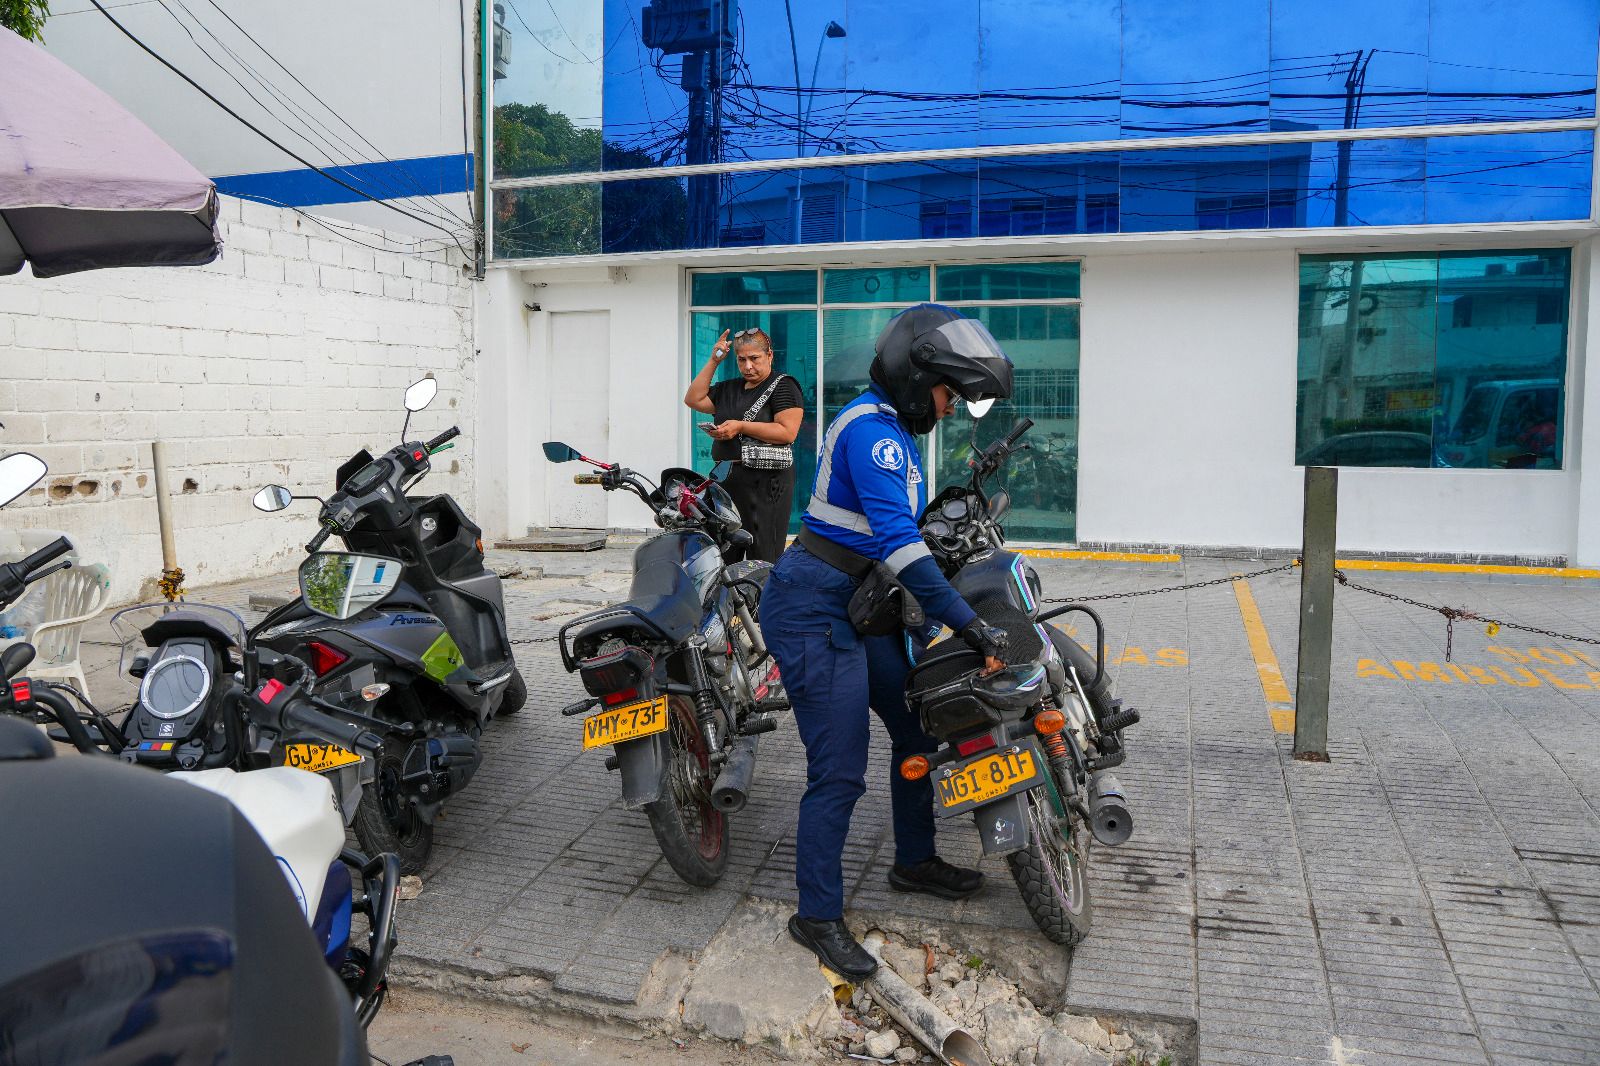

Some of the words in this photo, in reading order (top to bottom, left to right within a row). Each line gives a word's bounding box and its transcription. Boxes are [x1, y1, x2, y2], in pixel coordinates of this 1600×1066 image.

[587, 713, 620, 740] VHY
[628, 702, 663, 730] 73F
[609, 729, 640, 740] COLOMBIA
[287, 744, 313, 767] GJ
[318, 744, 352, 761] 94
[939, 768, 982, 805] MGI
[989, 753, 1027, 784] 81F
